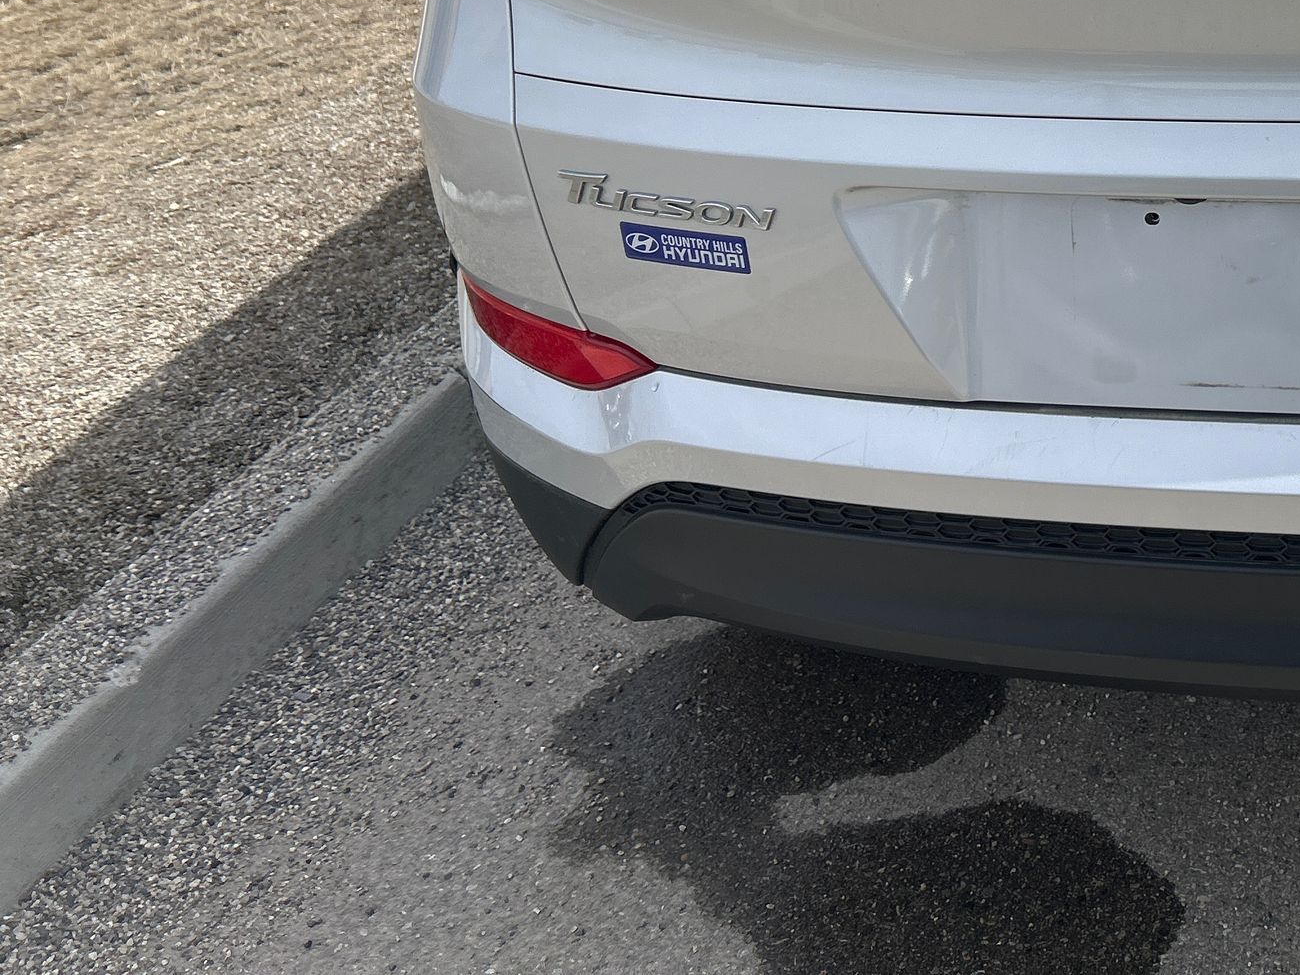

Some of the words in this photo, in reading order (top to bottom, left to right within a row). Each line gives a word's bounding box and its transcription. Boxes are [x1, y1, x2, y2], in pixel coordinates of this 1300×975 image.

[557, 169, 776, 231] TUCSON
[660, 233, 710, 250] COUNTRY
[712, 240, 743, 254] HILLS
[663, 246, 745, 269] HYUNDAI
